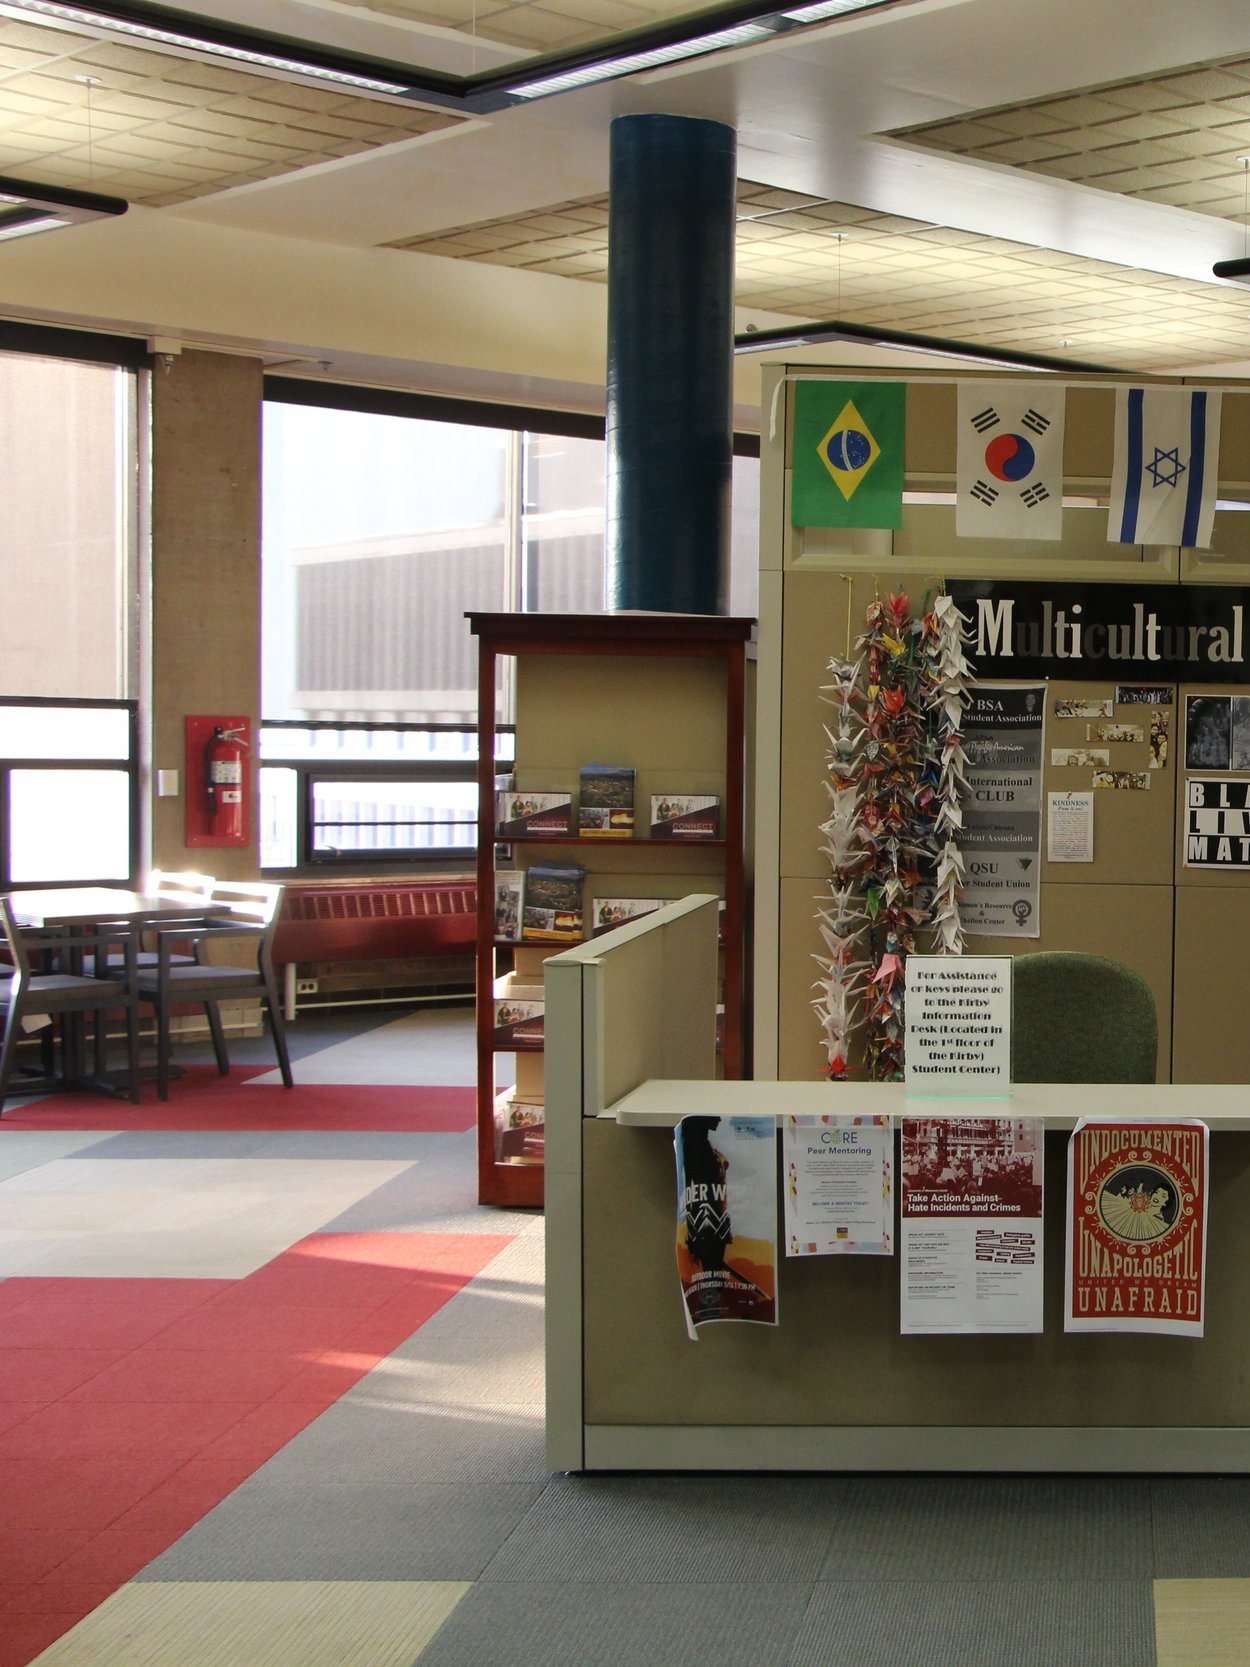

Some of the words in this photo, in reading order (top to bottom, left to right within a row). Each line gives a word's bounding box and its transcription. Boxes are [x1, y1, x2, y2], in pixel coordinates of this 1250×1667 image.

[976, 599, 1244, 664] Multicultural
[977, 699, 1004, 711] BSA
[994, 713, 1042, 723] Association
[967, 776, 1033, 787] International
[976, 789, 1015, 802] CLUB
[527, 820, 568, 828] CONNECT
[988, 834, 1033, 842] Association
[970, 862, 998, 875] QSU
[972, 880, 1003, 888] Student
[1006, 881, 1031, 889] Union
[917, 971, 937, 980] For
[938, 971, 997, 980] Assistance
[911, 985, 923, 993] or
[925, 985, 951, 994] keys
[952, 986, 989, 994] please
[990, 986, 1003, 994] go
[924, 999, 935, 1007] to
[937, 999, 956, 1007] the
[958, 998, 990, 1007] Kirby
[922, 1012, 992, 1021] Information
[911, 1025, 938, 1034] Desk
[939, 1025, 988, 1035] (Located
[990, 1026, 1002, 1034] in
[919, 1039, 938, 1047] the
[955, 1039, 981, 1048] floor
[983, 1039, 995, 1048] of
[928, 1052, 947, 1060] the
[949, 1052, 984, 1061] Kirby)
[912, 1065, 957, 1074] Student
[959, 1065, 1001, 1075] Center)
[807, 1147, 826, 1155] Peer
[828, 1146, 872, 1156] Mentoring
[1079, 1129, 1200, 1198] UNDOCUMENTED
[907, 1193, 928, 1203] Take
[931, 1193, 961, 1203] Action
[908, 1203, 929, 1212] Hate
[930, 1203, 970, 1212] Incidents
[971, 1203, 988, 1212] and
[990, 1203, 1021, 1212] Crimes
[1078, 1216, 1199, 1281] UNAPOLOGETIC
[1079, 1278, 1124, 1286] UNITED
[1159, 1279, 1198, 1288] DREAM
[1078, 1287, 1198, 1316] UNAFRAID
